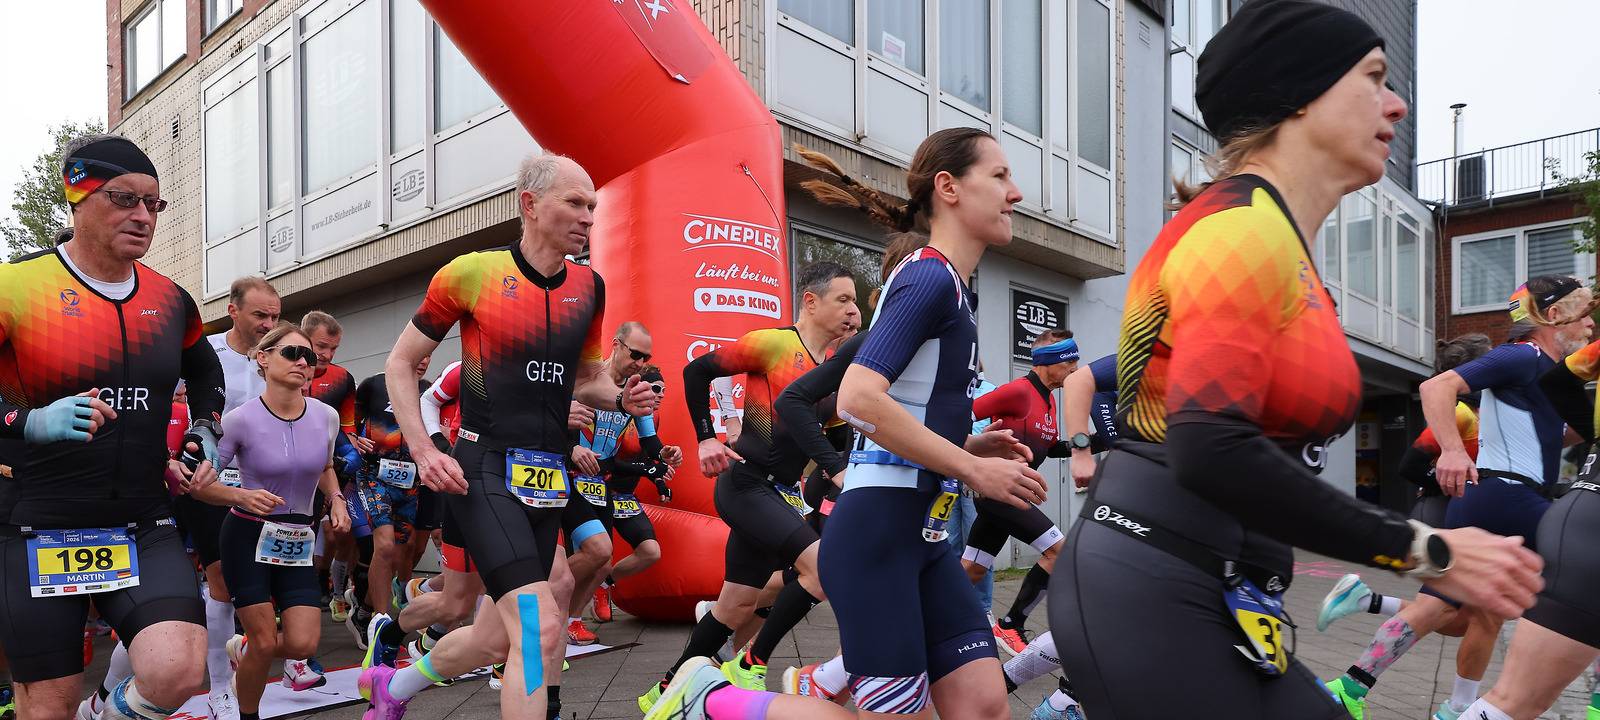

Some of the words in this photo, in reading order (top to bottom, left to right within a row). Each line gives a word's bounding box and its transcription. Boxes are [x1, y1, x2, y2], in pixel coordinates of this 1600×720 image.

[70, 172, 86, 184] DTU
[403, 174, 417, 193] LB
[277, 230, 287, 246] LB
[683, 219, 781, 255] CINEPLEX
[694, 262, 740, 281] Läuft
[741, 264, 761, 282] bei
[716, 294, 746, 307] DAS
[748, 296, 778, 313] KINO
[1029, 306, 1045, 325] LB
[526, 360, 565, 386] GER
[97, 387, 149, 411] GER
[1100, 404, 1118, 437] FRANCE
[596, 427, 618, 440] BEL
[387, 469, 409, 481] 529
[523, 467, 554, 490] 201
[533, 490, 548, 498] DIRK
[582, 482, 602, 495] 206
[617, 501, 635, 510] 230
[270, 539, 304, 555] 533
[56, 547, 114, 573] 198
[67, 573, 105, 583] MARTIN
[957, 640, 989, 654] HUUB
[1039, 650, 1062, 665] veloTo
